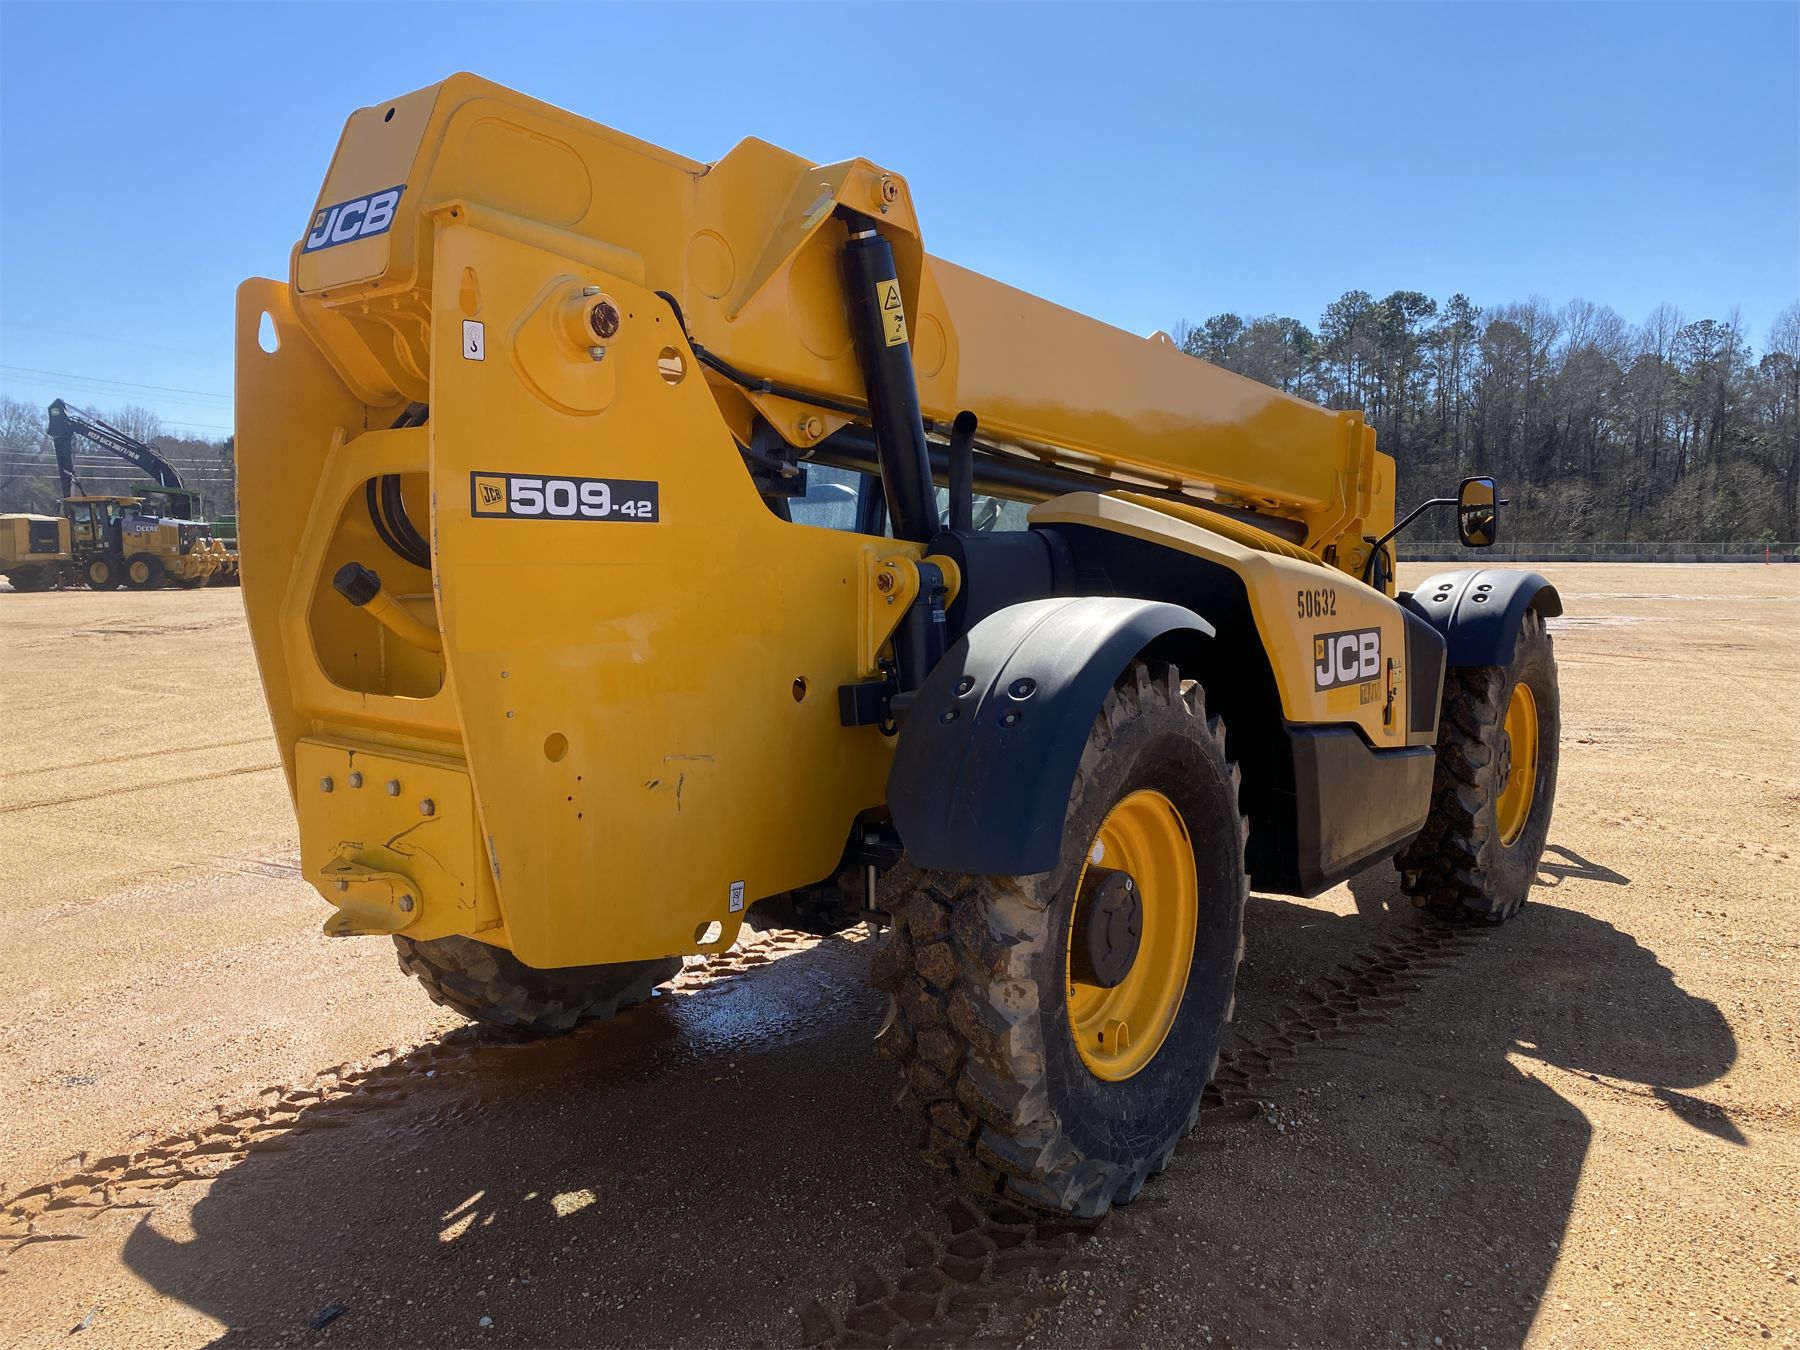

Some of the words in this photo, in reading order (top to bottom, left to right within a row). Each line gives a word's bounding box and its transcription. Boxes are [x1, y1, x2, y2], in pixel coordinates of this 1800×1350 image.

[306, 190, 399, 249] JCB
[483, 486, 502, 503] JCB
[510, 478, 652, 517] 509-42
[1297, 589, 1337, 619] 50632
[1316, 632, 1380, 687] JCB
